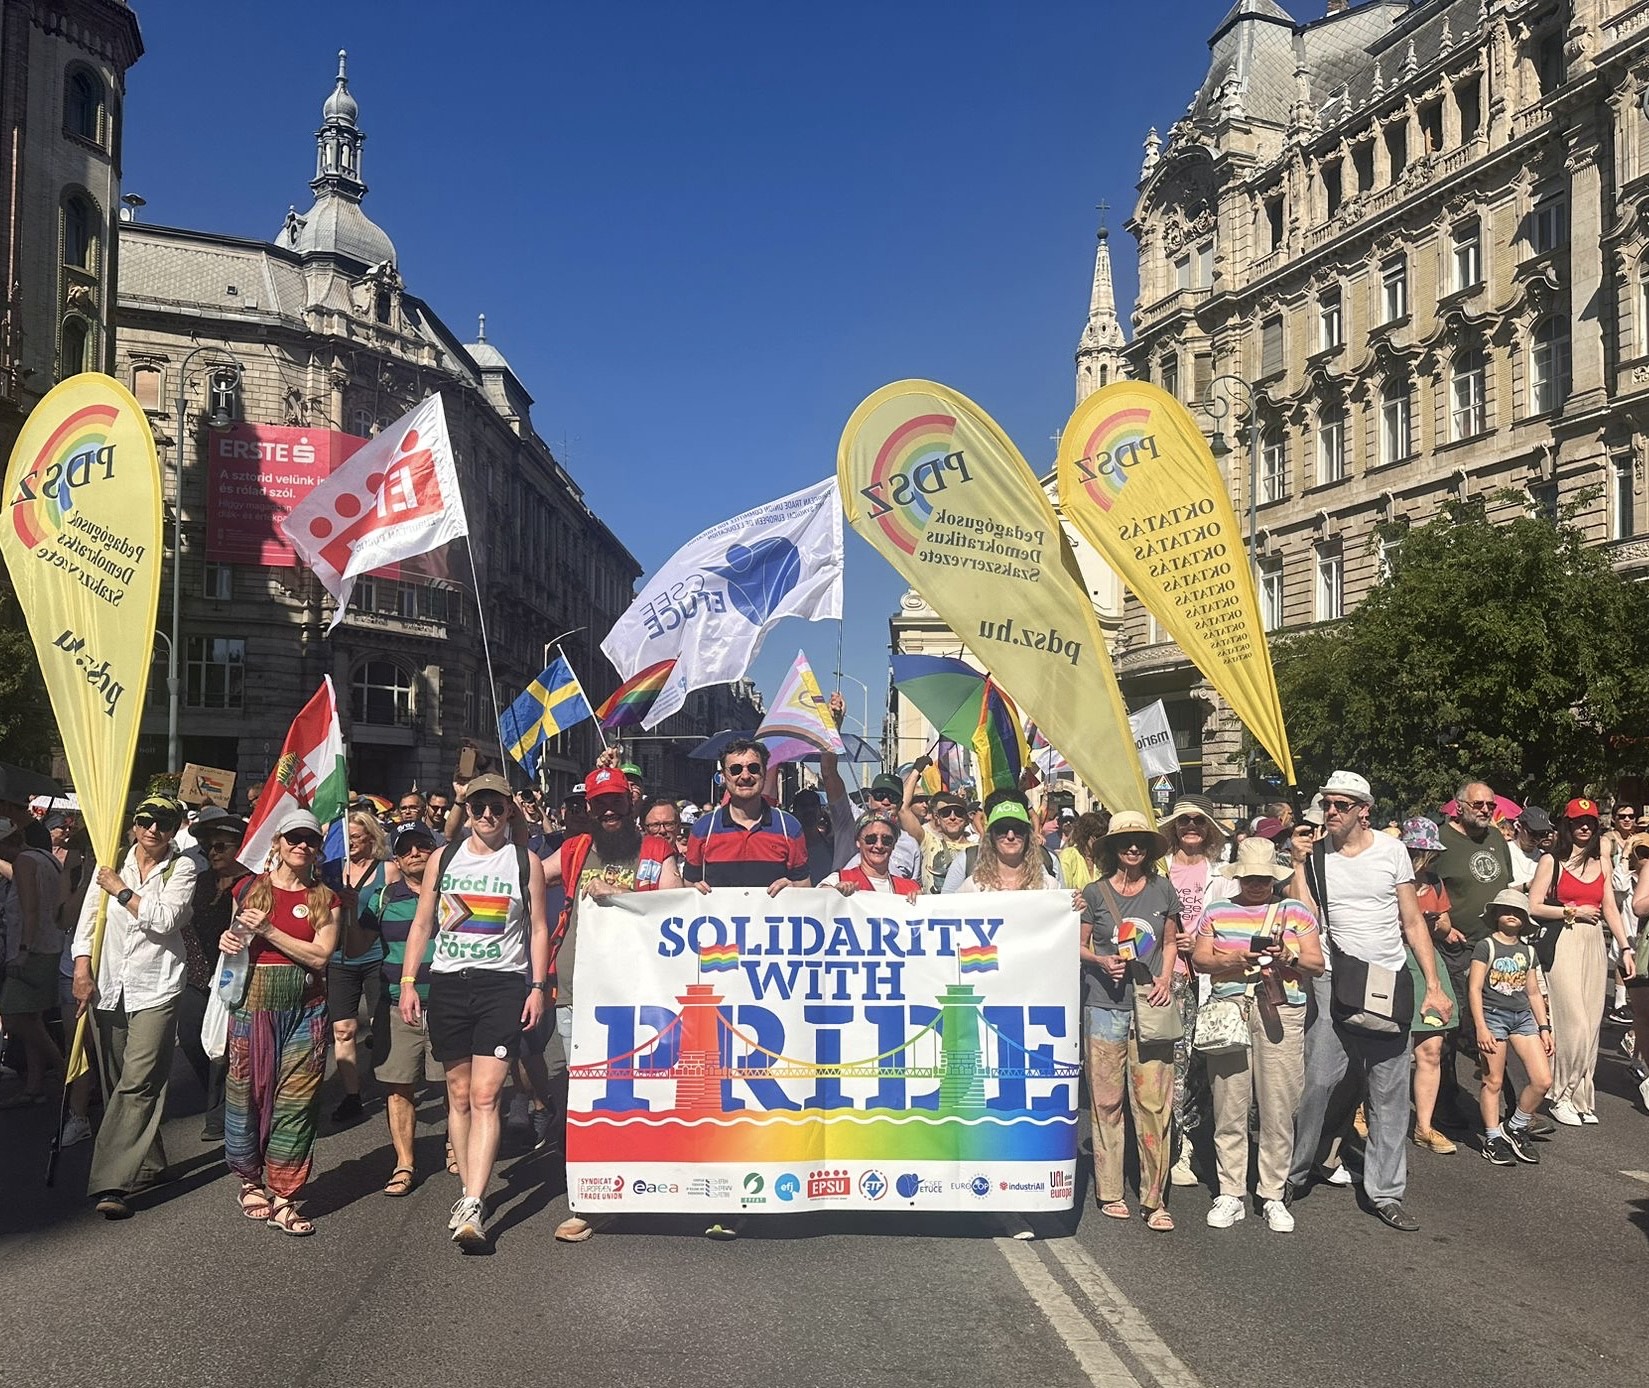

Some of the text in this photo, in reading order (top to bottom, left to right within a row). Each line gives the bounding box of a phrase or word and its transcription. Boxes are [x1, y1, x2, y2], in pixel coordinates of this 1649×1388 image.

[221, 439, 289, 462] ERSTE
[220, 470, 229, 479] A
[232, 471, 272, 483] sztorid
[275, 473, 314, 485] velünk
[220, 484, 296, 498] és rólad szól.
[492, 877, 513, 895] in
[657, 915, 1004, 958] SOLIDARITY
[440, 933, 501, 959] Fórsa
[741, 961, 906, 1001] WITH
[592, 1005, 1079, 1111] PRIDE
[580, 1177, 612, 1185] SYNDICAT
[865, 1181, 882, 1191] ETF
[1008, 1181, 1045, 1191] industriAll
[1050, 1171, 1064, 1188] UNI
[632, 1180, 679, 1195] eaea
[780, 1183, 794, 1193] efj
[812, 1181, 845, 1195] EPSU
[919, 1185, 943, 1193] ETUCE
[1050, 1187, 1072, 1200] europa
[580, 1192, 623, 1200] TRADE UNION
